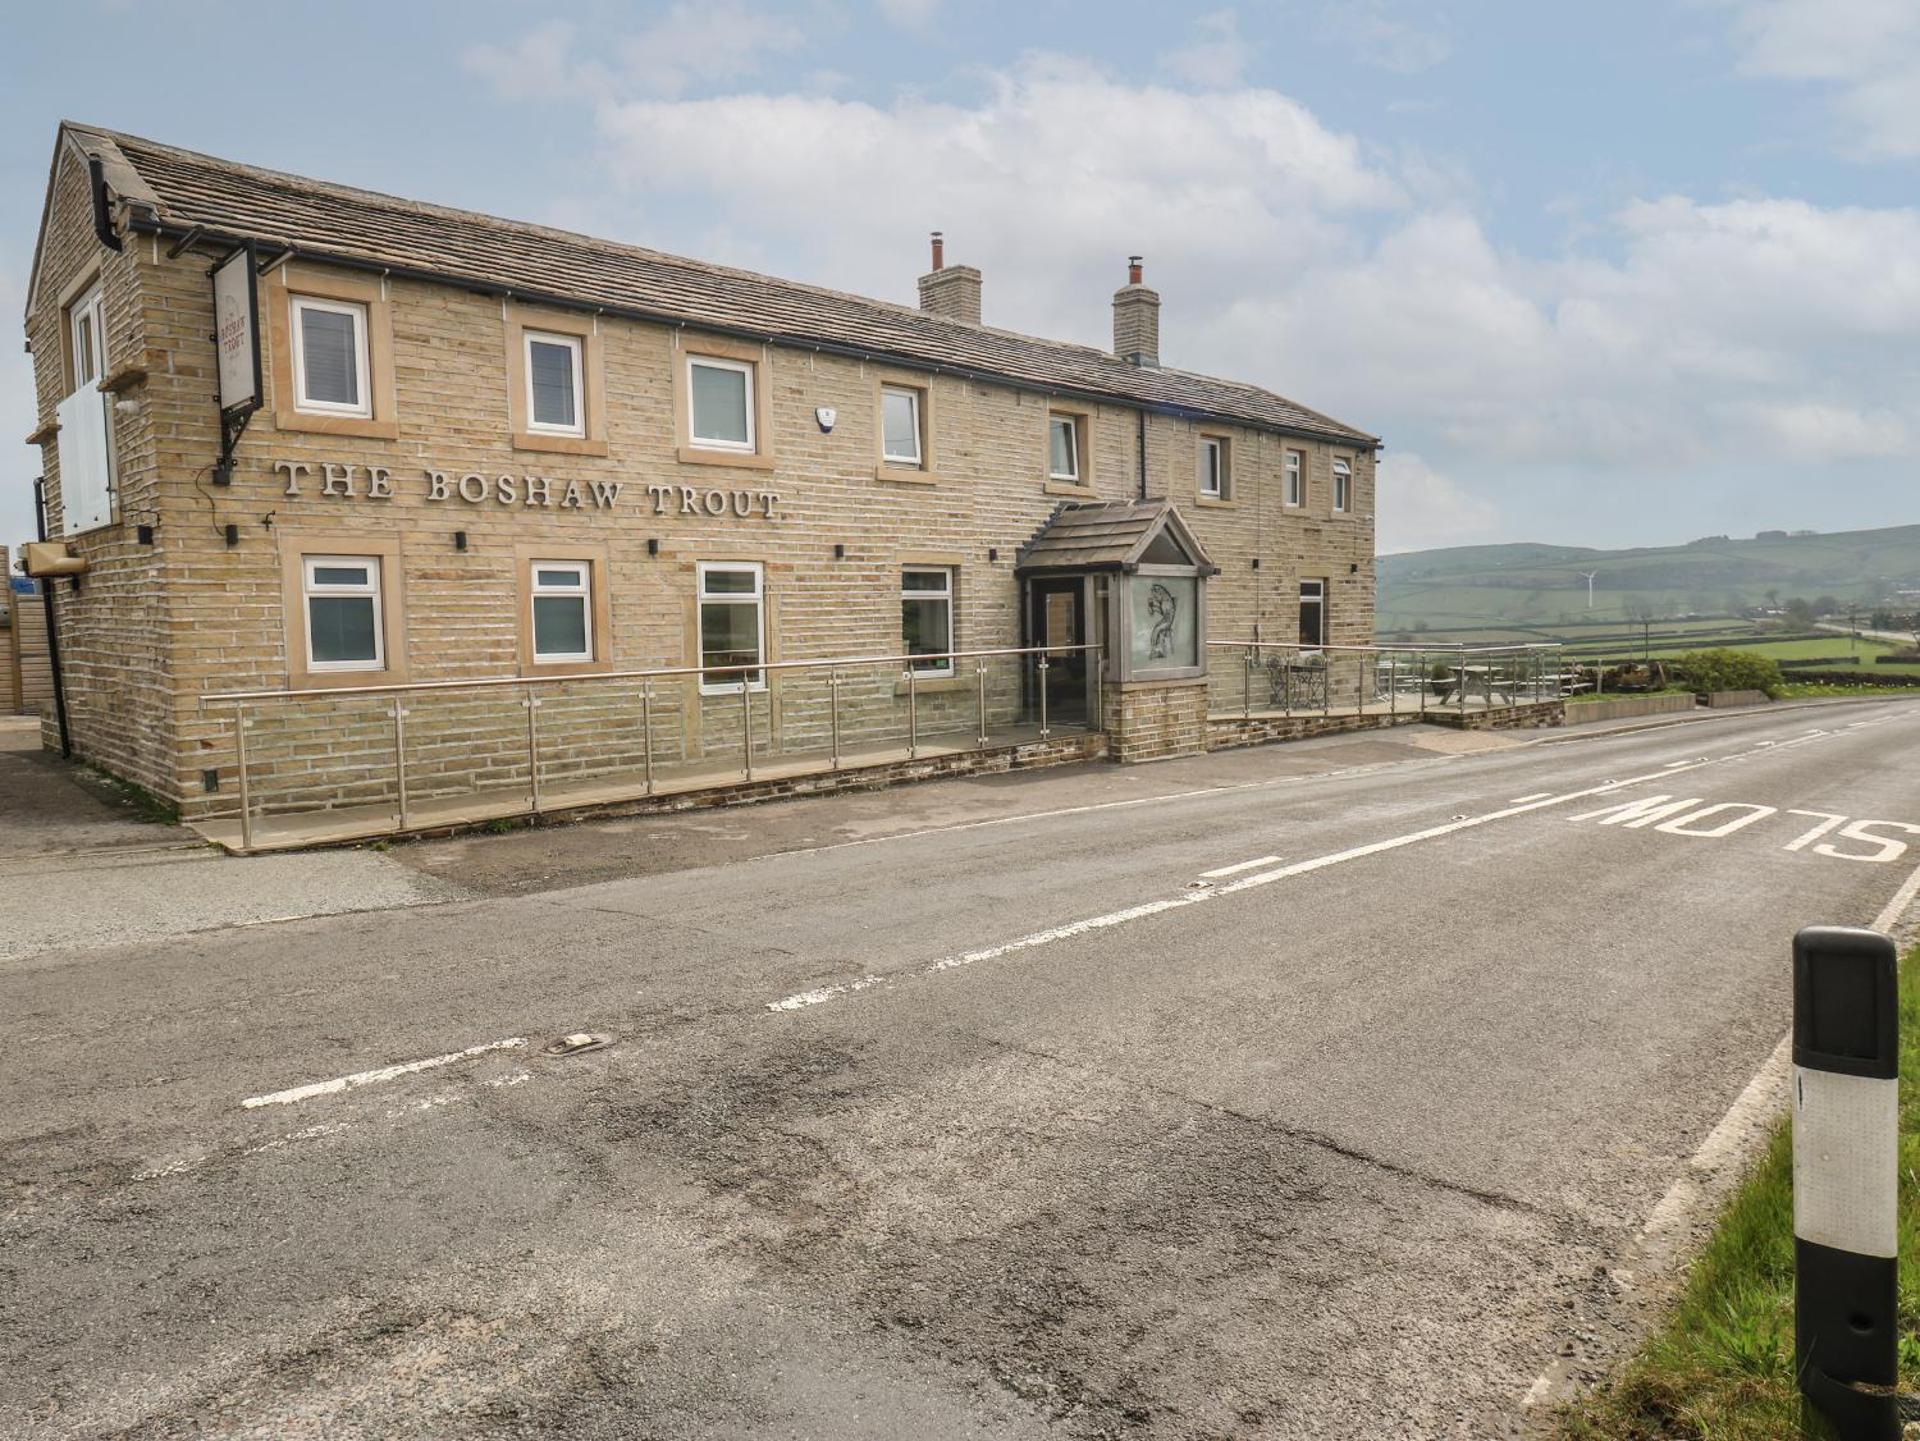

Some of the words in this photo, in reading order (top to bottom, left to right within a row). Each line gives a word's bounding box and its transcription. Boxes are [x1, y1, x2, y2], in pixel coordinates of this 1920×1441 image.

[274, 460, 394, 498] THE
[425, 469, 623, 509] BOSHAW
[648, 484, 780, 518] TROUT
[1566, 795, 1920, 862] SLOW
